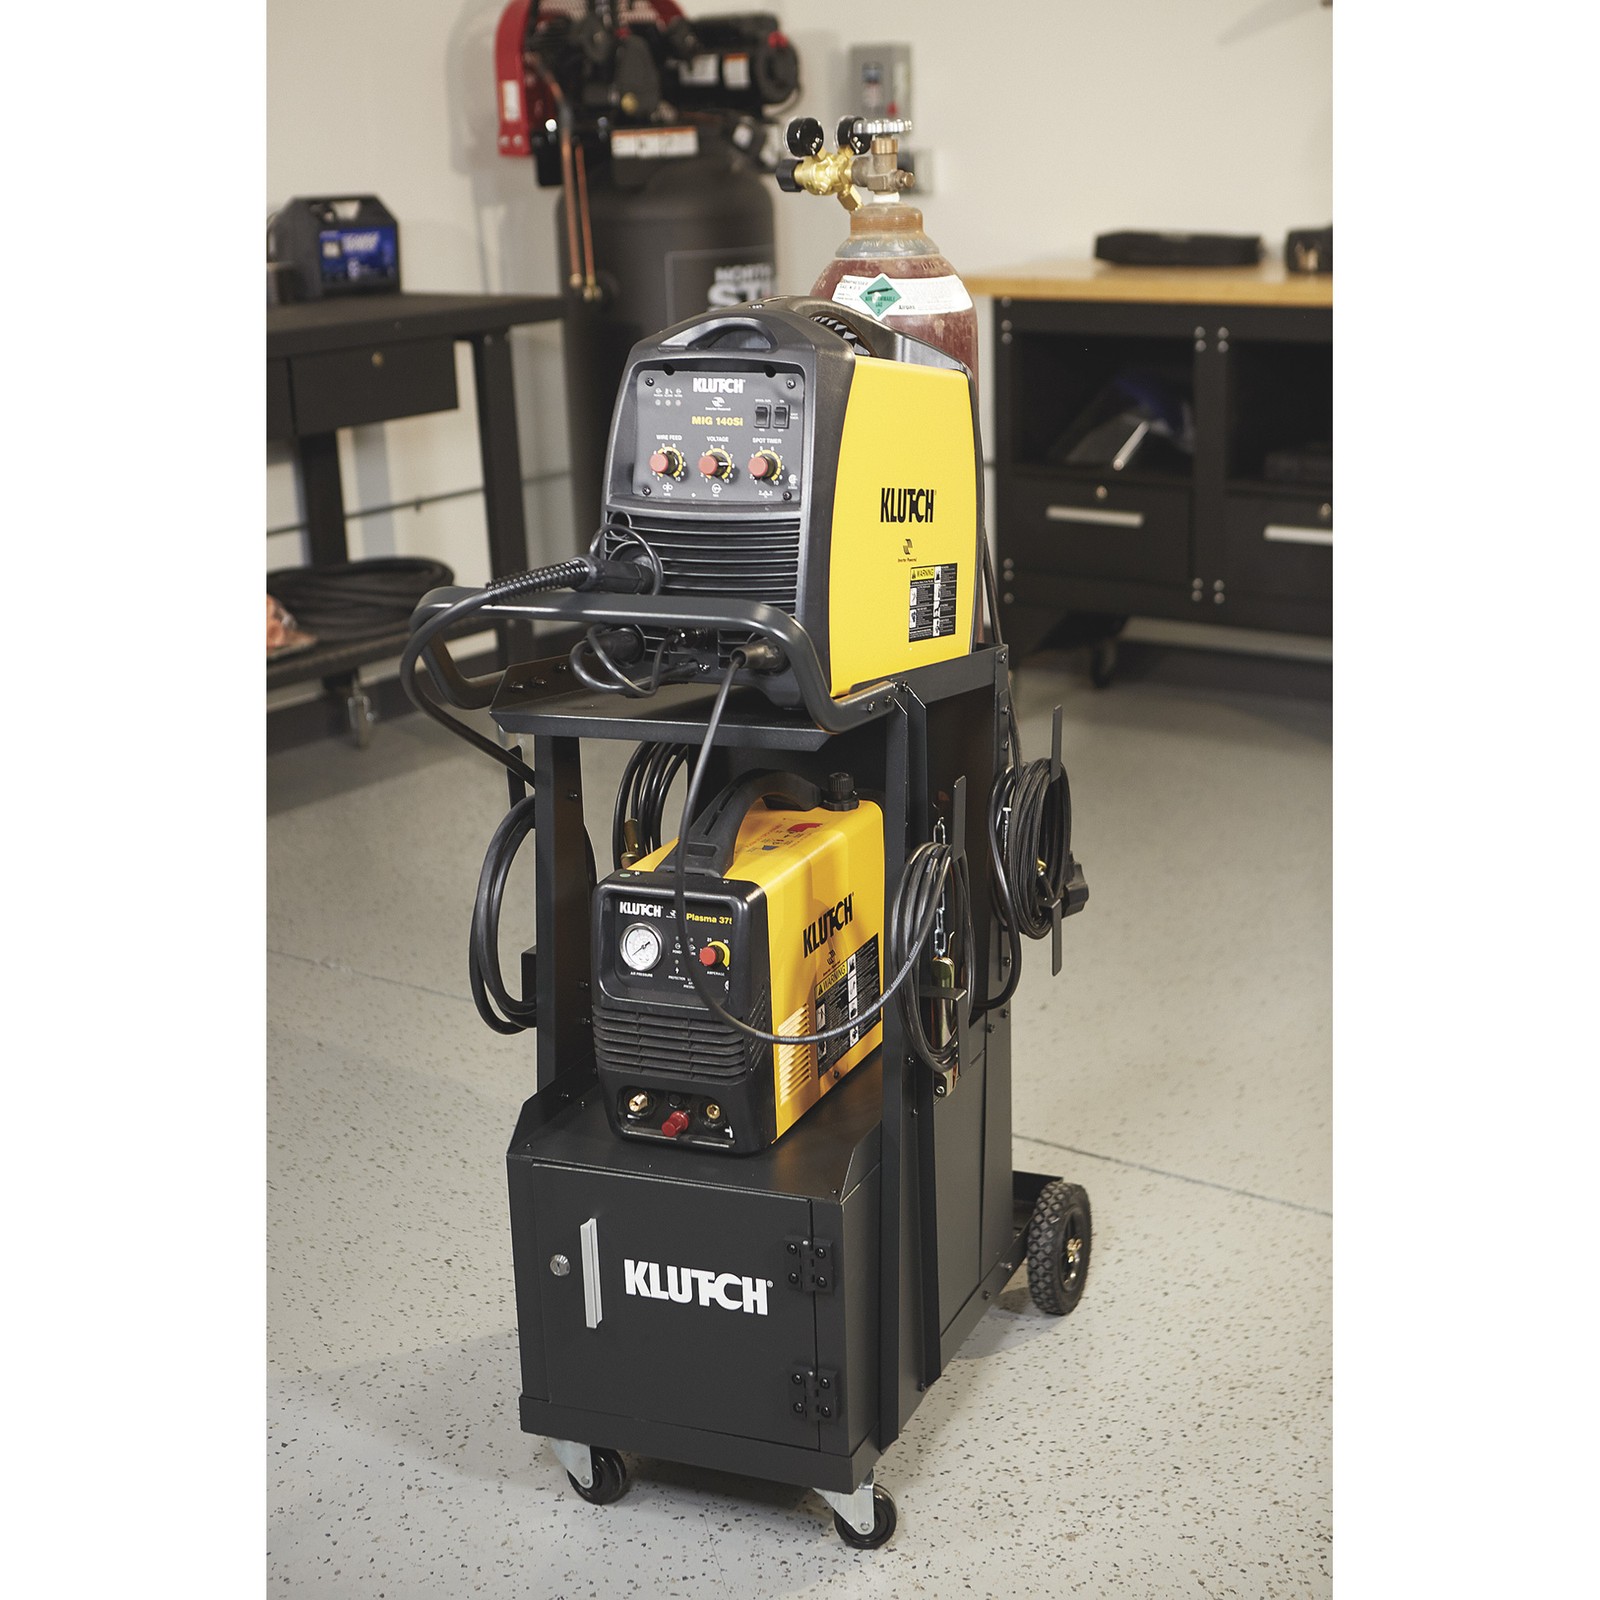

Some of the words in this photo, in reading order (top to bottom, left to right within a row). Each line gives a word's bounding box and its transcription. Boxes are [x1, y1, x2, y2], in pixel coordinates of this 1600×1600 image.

[693, 378, 744, 394] KLUTCH
[692, 416, 713, 426] MIG
[880, 488, 934, 523] KLUTCH
[620, 901, 661, 918] KLUTCH
[686, 913, 717, 923] Plasma
[803, 892, 853, 958] KLUTCH
[823, 964, 846, 990] WARNING
[624, 1259, 768, 1316] KLUTCH
